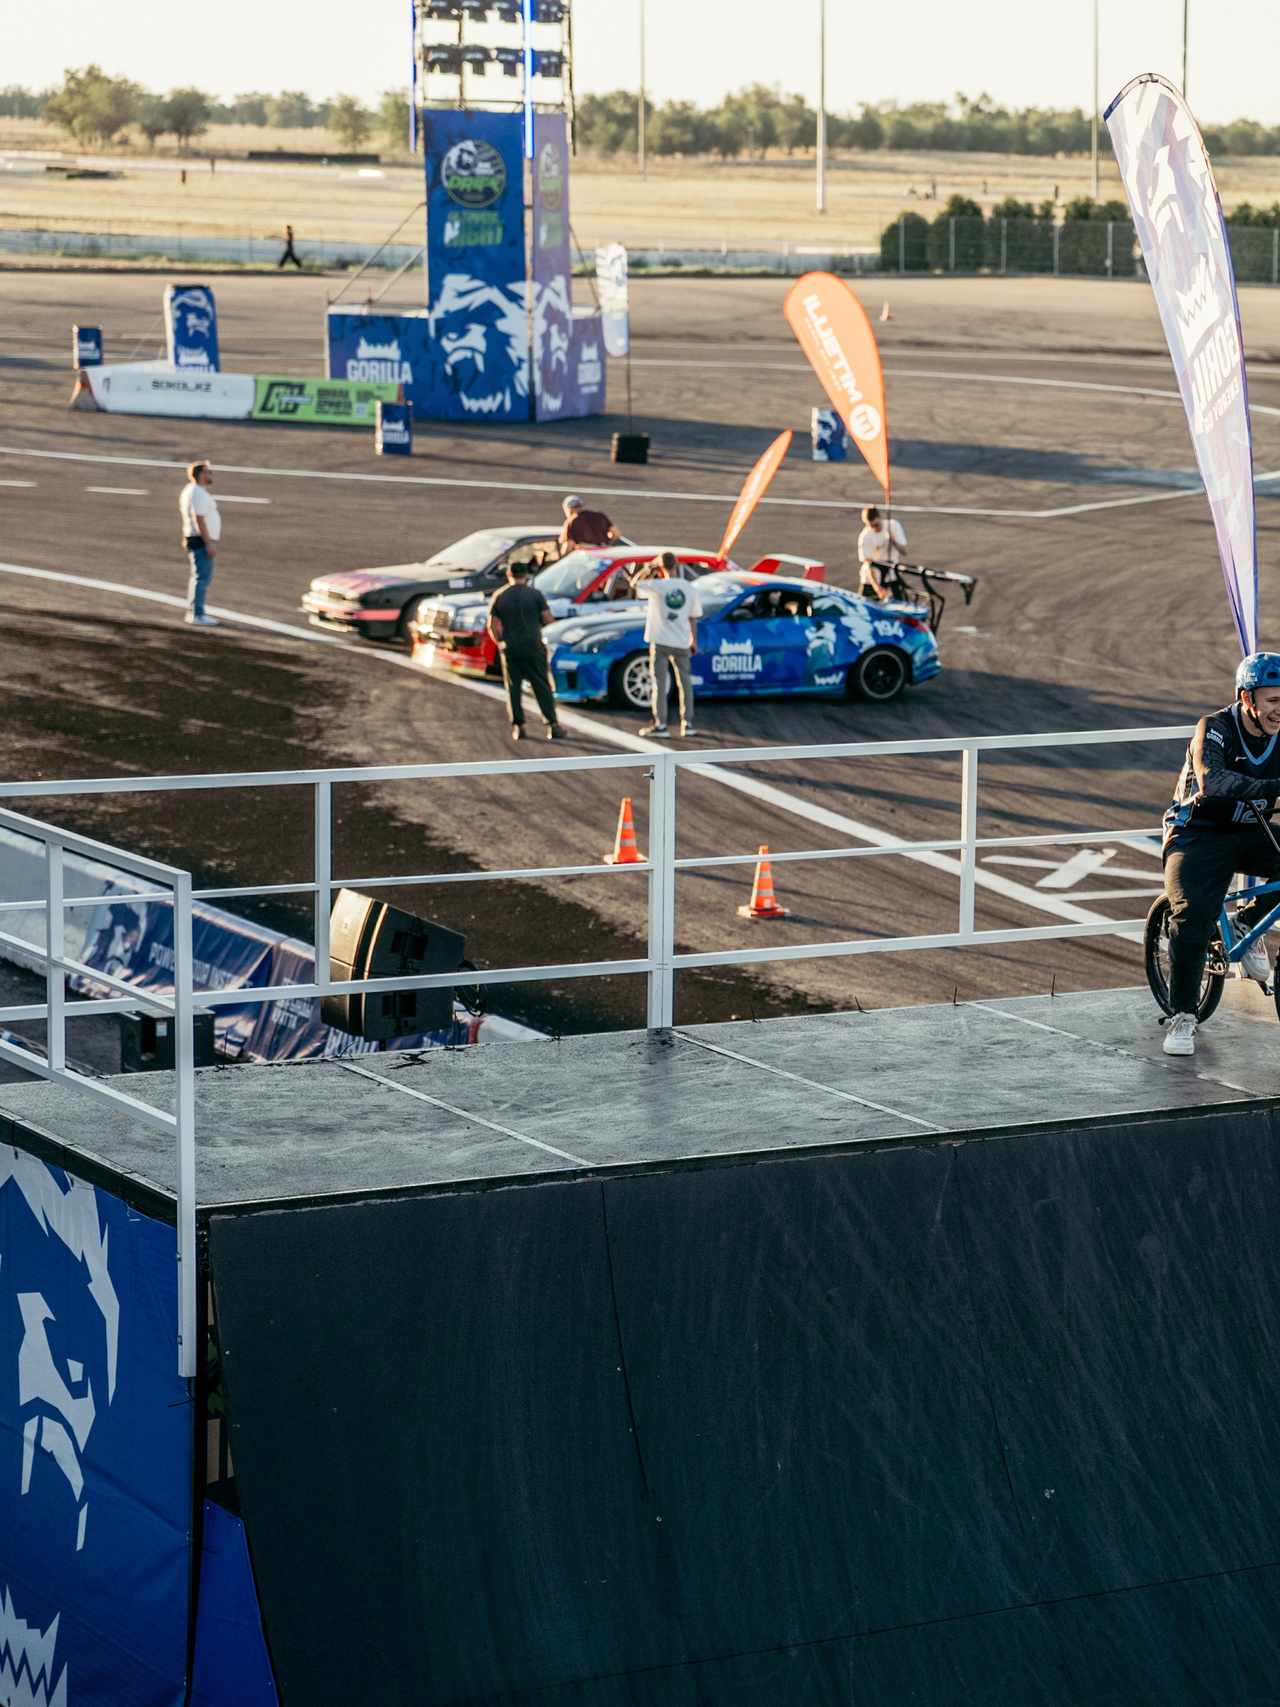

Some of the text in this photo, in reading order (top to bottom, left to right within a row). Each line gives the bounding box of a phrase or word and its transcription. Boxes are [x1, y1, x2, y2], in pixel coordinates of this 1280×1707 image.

[346, 359, 414, 385] GORILLA
[873, 620, 905, 638] 194
[711, 654, 763, 673] GORILLA
[1231, 798, 1269, 823] 12
